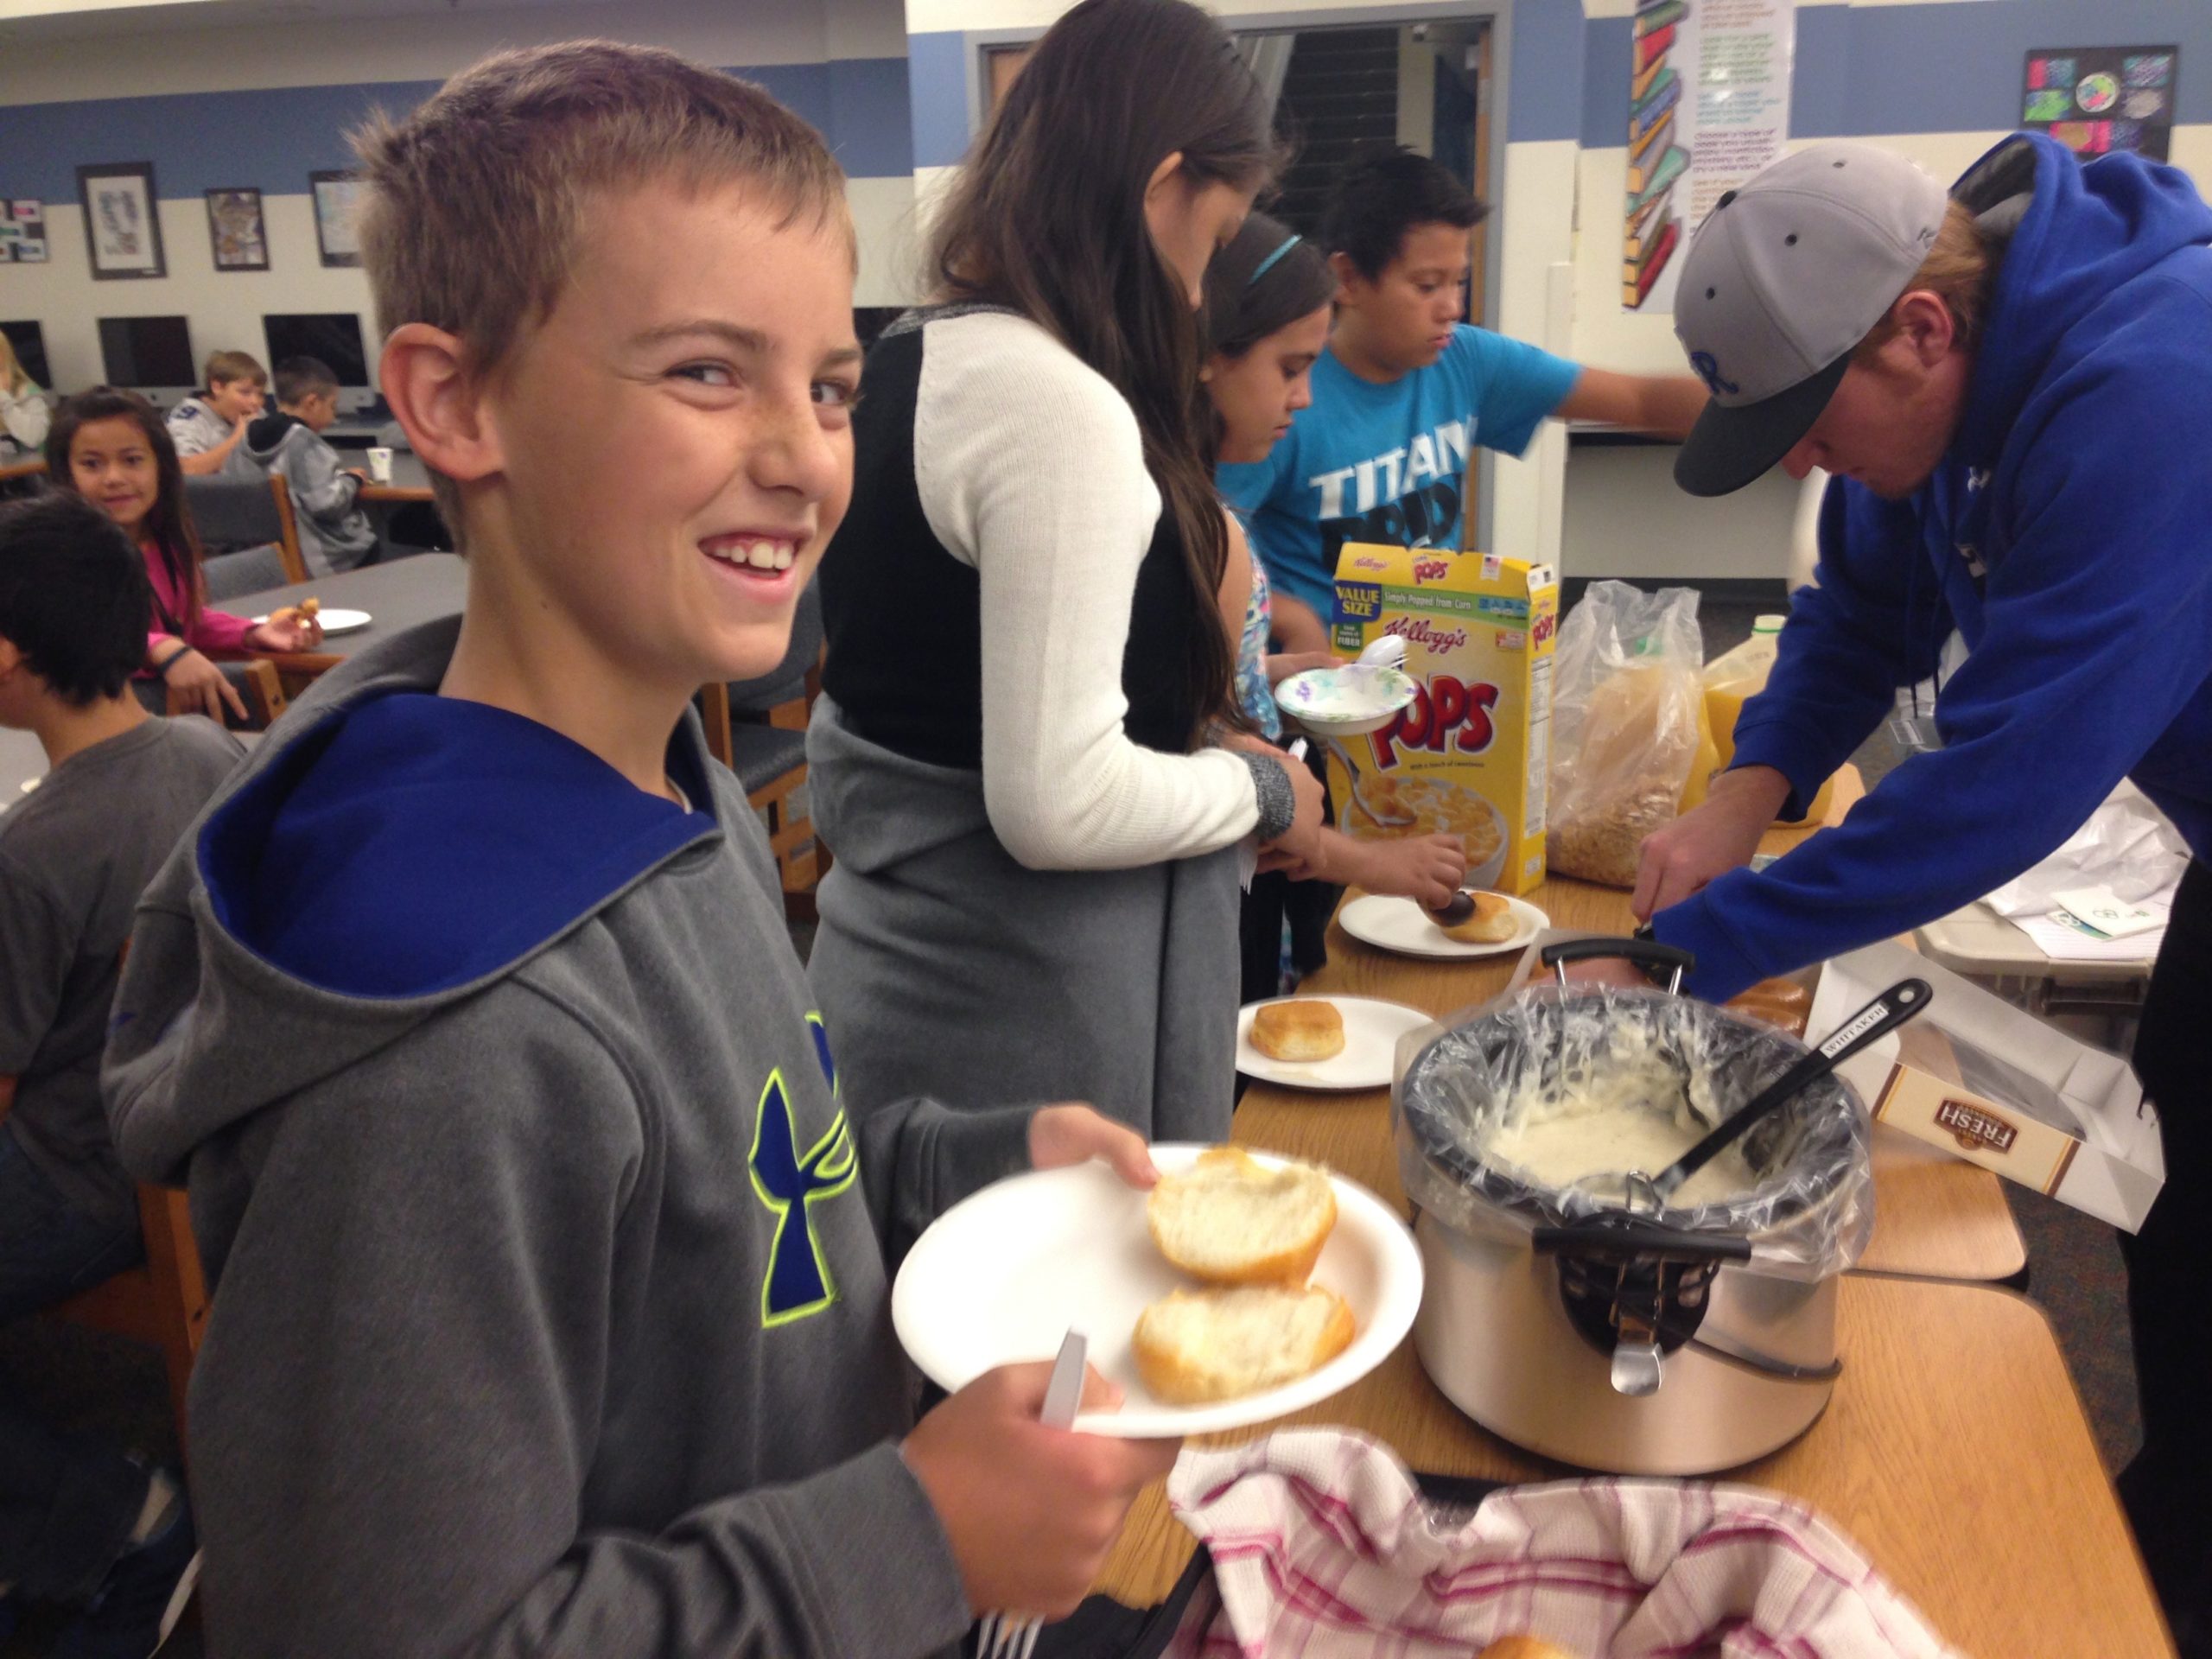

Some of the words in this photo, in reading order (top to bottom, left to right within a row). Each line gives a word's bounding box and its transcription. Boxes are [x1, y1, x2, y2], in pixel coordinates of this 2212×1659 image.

[1414, 561, 1448, 585] POPS
[1336, 585, 1380, 603] VALUE
[1384, 589, 1407, 604] Simply
[1408, 594, 1434, 607] Popped
[1436, 596, 1452, 607] from
[1455, 600, 1471, 610] Corn
[1342, 601, 1373, 617] SIZE
[1338, 636, 1361, 647] FIBER
[1382, 616, 1468, 655] Kellogg's
[1940, 1104, 2012, 1148] FRESH
